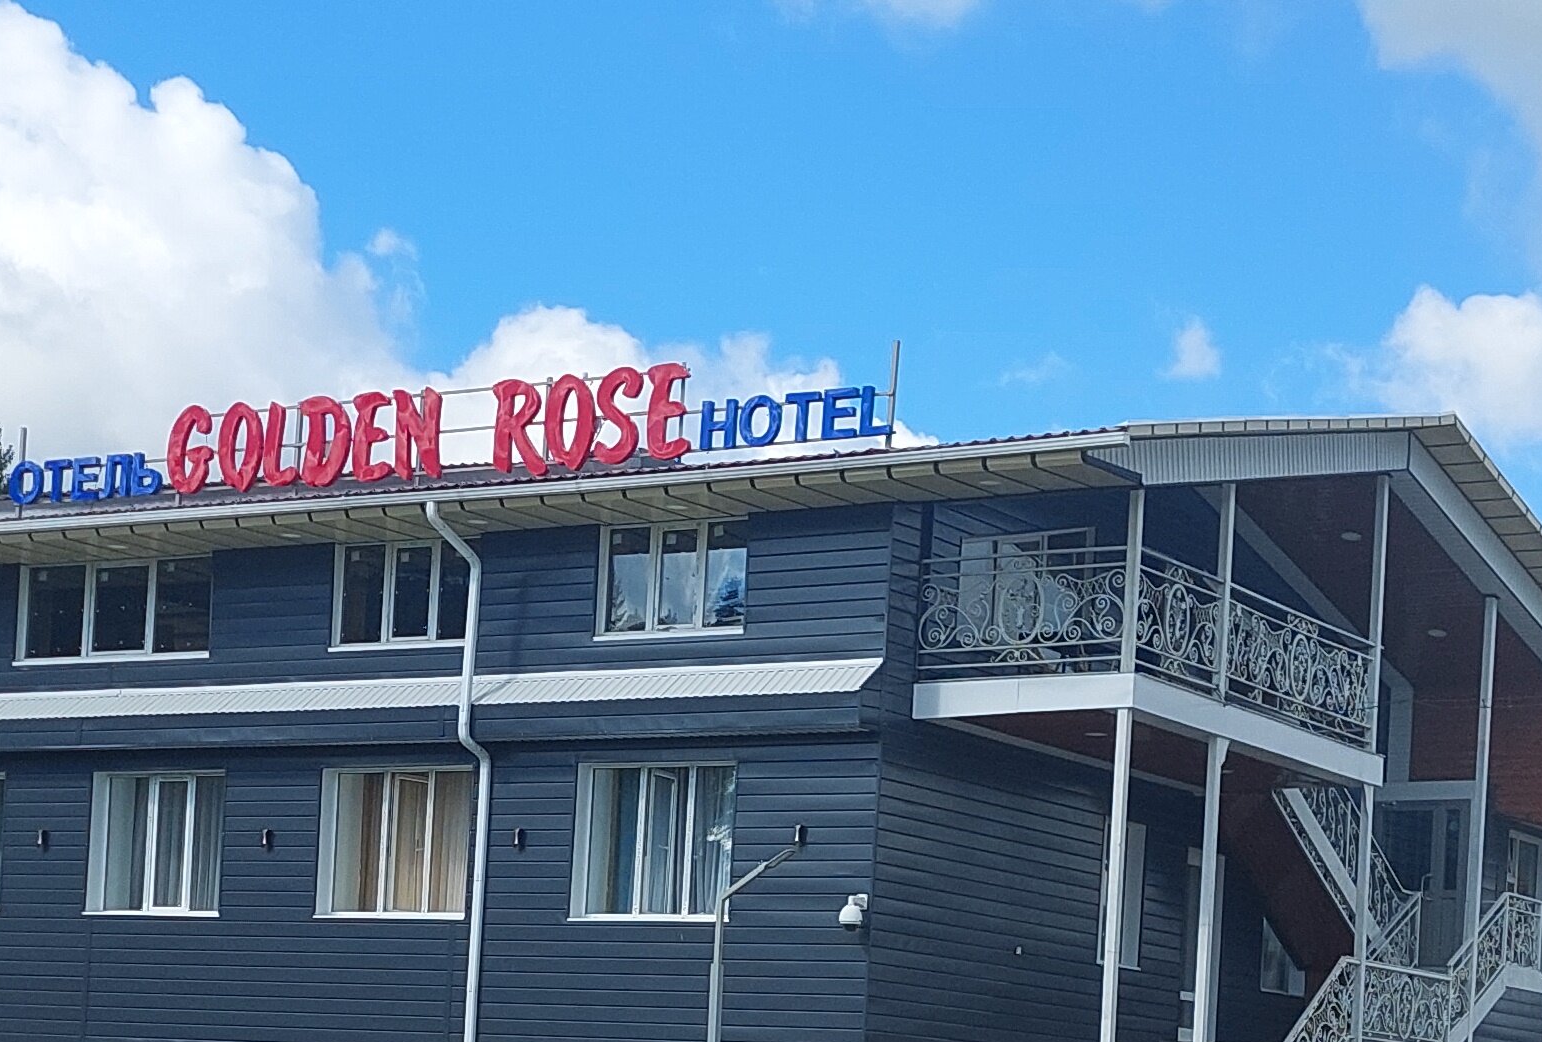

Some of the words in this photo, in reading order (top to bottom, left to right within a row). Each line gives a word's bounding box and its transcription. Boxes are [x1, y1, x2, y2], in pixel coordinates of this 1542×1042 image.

[167, 386, 443, 494] GOLDEN
[493, 362, 691, 476] ROSE
[699, 386, 894, 450] HOTEL
[9, 452, 163, 505] ОТЕЛЬ
